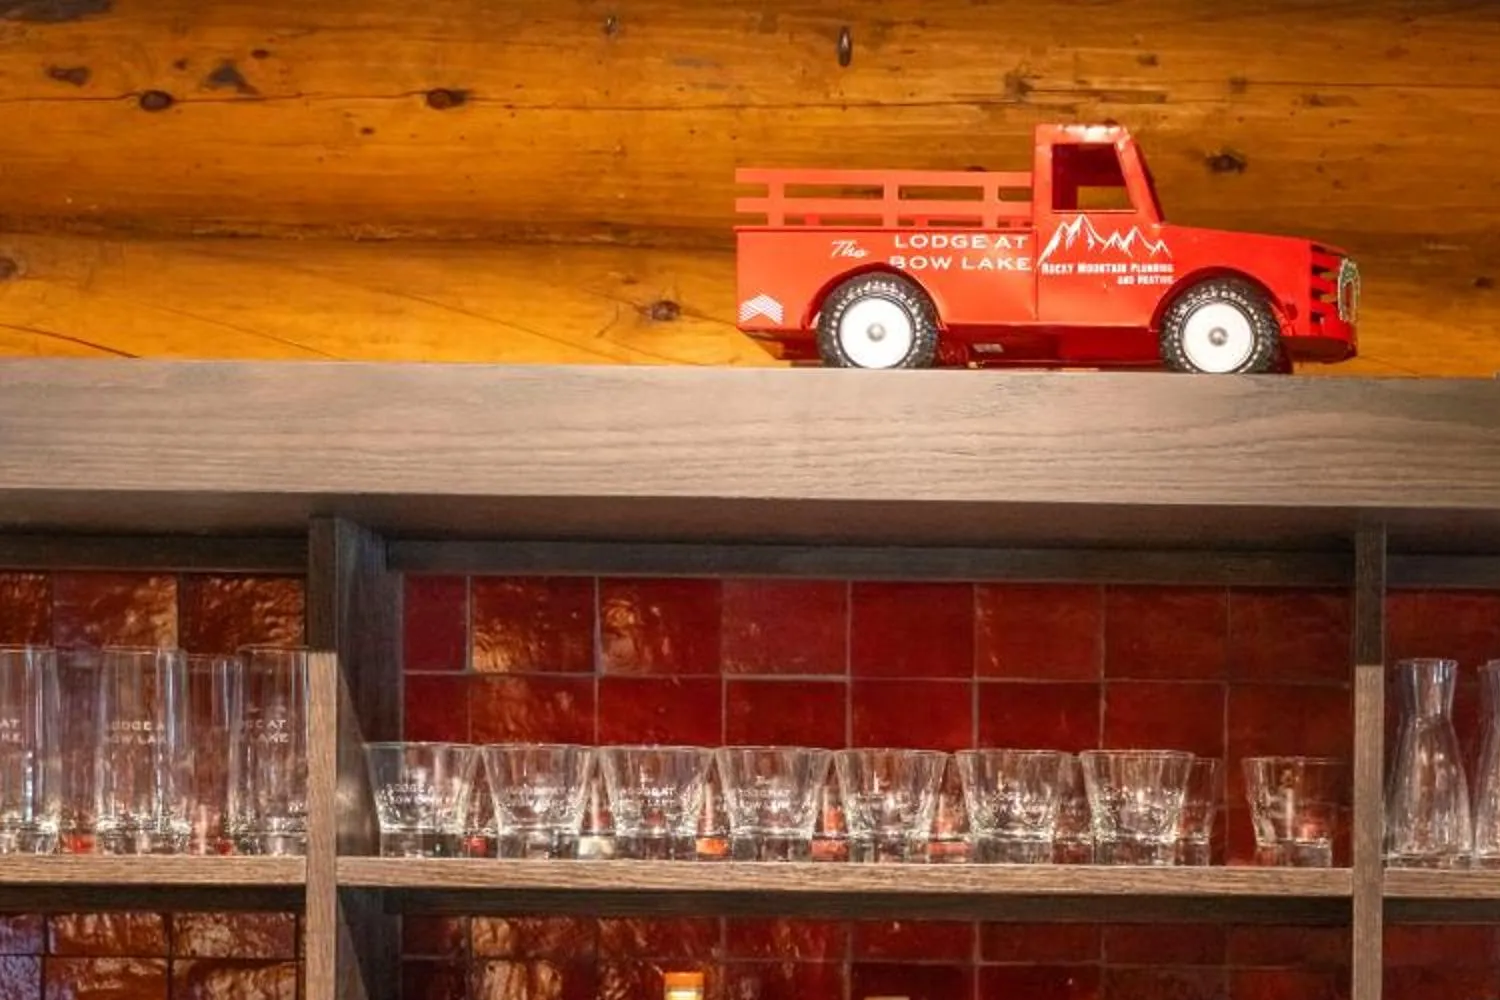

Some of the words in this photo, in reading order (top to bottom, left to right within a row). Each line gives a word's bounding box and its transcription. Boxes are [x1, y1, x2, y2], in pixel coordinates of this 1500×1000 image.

[831, 239, 872, 258] The
[895, 234, 988, 249] LODGE
[994, 234, 1029, 249] AT
[889, 255, 952, 270] BOW
[961, 256, 1033, 271] LAKE
